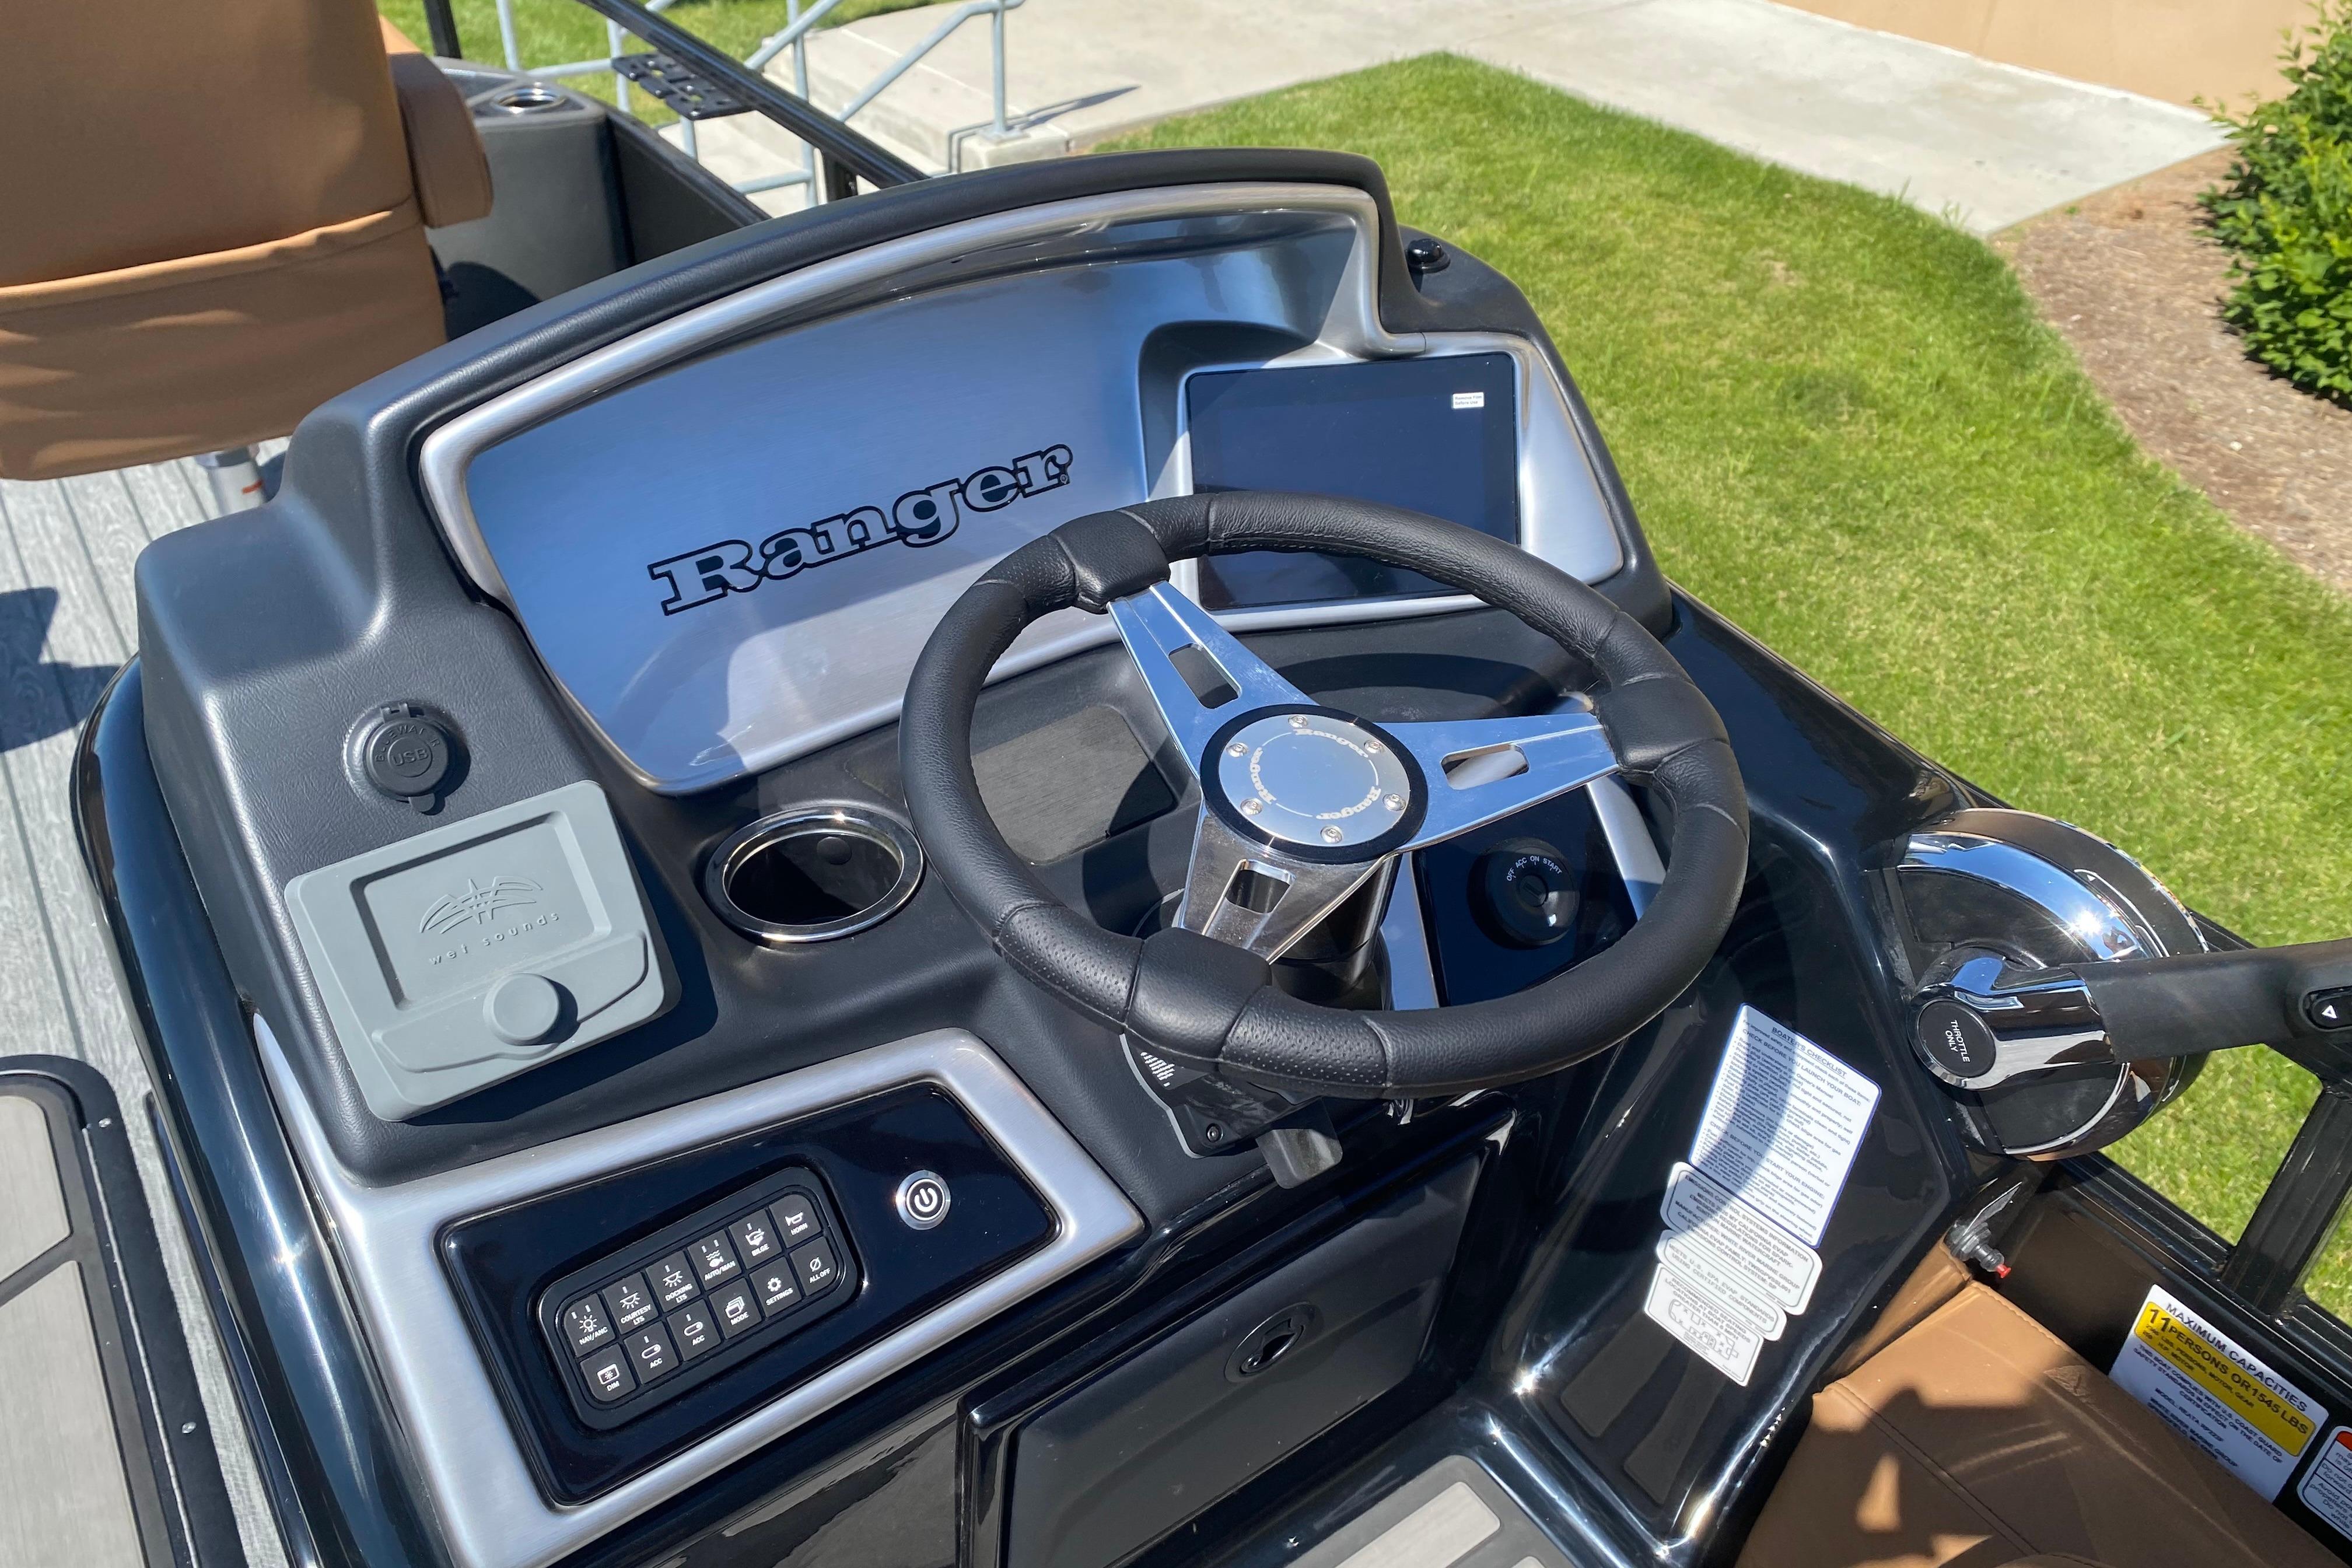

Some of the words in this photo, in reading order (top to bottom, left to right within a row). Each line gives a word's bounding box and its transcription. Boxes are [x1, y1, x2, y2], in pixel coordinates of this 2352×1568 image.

[648, 443, 1073, 616] Ranger
[393, 748, 429, 766] USB
[1293, 729, 1368, 758] Ranger
[1506, 868, 1515, 881] OFF
[1515, 857, 1527, 868] ACC
[1543, 858, 1563, 874] START
[429, 944, 468, 965] wet
[482, 911, 560, 946] sounds
[1772, 1026, 1805, 1051] BOATER'S
[1806, 1048, 1847, 1077] CHECKLIST
[1945, 1030, 1958, 1052] ONLY
[1951, 1020, 1971, 1062] THROTTLE
[1742, 1028, 1763, 1044] CHECK
[1763, 1041, 1787, 1059] BEFORE
[1787, 1056, 1800, 1068] YOU
[1800, 1065, 1825, 1083] LAUNCH
[1826, 1081, 1843, 1094] YOUR
[1770, 1037, 1783, 1047] safety
[1814, 1064, 1828, 1075] check
[1828, 1073, 1839, 1082] each
[1844, 1083, 1857, 1093] these
[1796, 1073, 1815, 1087] Owner's
[1815, 1085, 1833, 1099] Manual
[1710, 1120, 1729, 1135] CHECK
[1730, 1133, 1752, 1150] BEFORE
[1753, 1149, 1765, 1159] YOU
[1766, 1157, 1784, 1172] START
[1784, 1170, 1801, 1183] YOUR
[790, 1222, 808, 1236] HORN
[1677, 1210, 1709, 1236] CALIFORNIA
[1710, 1233, 1725, 1247] EVAP
[1685, 1174, 1714, 1197] EMISSIONS
[1714, 1195, 1741, 1216] CONTROL
[1742, 1213, 1768, 1234] SYSTEMS
[1769, 1232, 1808, 1262] INFORMATION
[1696, 1192, 1715, 1208] MEETS
[1728, 1213, 1737, 1223] MY
[1737, 1220, 1772, 1247] CALIFORNIA
[1772, 1244, 1788, 1258] EVAP
[1687, 1224, 1716, 1248] EMISSIONS
[1716, 1245, 1742, 1266] CONTROL
[1696, 1205, 1720, 1224] IGNITION
[1720, 1222, 1741, 1240] MARINE
[1742, 1237, 1781, 1266] WATERCRAFT
[1719, 1214, 1758, 1244] REGULATIONS
[1759, 1241, 1771, 1253] FOR
[751, 1242, 769, 1256] BILGE
[1720, 1232, 1738, 1247] WHITE
[1738, 1244, 1756, 1259] RIVER
[1756, 1256, 1778, 1275] MARINE
[1779, 1272, 1800, 1290] GROUP
[704, 1260, 736, 1281] AUTO/MAN
[808, 1272, 821, 1283] ALL
[820, 1267, 831, 1278] OFF
[1668, 1243, 1687, 1259] MEETS
[1689, 1258, 1704, 1272] U.S.
[1707, 1270, 1719, 1282] EPA
[1721, 1281, 1737, 1296] EVAP
[1740, 1294, 1775, 1322] STANDARDS
[664, 1283, 693, 1301] DOCKING
[675, 1293, 688, 1303] LTS
[765, 1287, 793, 1306] SETTINGS
[1671, 1253, 1690, 1269] USING
[1692, 1268, 1726, 1294] CERTIFIED
[1728, 1293, 1767, 1324] COMPONENTS
[620, 1303, 652, 1325] COURTESY
[632, 1314, 645, 1325] LTS
[730, 1311, 749, 1325] MODE
[1664, 1278, 1698, 1305] LOCATIONS
[1699, 1303, 1707, 1311] AT
[1707, 1309, 1725, 1324] BOAT
[1726, 1322, 1751, 1343] SPEEDS
[1671, 1278, 1718, 1314] RECOMMENDED
[1719, 1312, 1746, 1334] SEATING
[1672, 1290, 1702, 1314] GREATER
[1702, 1311, 1718, 1326] THAN
[1724, 1327, 1738, 1340] MPH
[579, 1326, 608, 1346] NAV/ANC
[691, 1334, 705, 1346] ACC
[649, 1357, 663, 1368] ACC
[2150, 1309, 2171, 1332] 11
[2168, 1325, 2230, 1375] PERSONS
[2230, 1371, 2252, 1392] OR
[2250, 1386, 2281, 1414] 1545
[2280, 1409, 2309, 1435] LBS
[2166, 1303, 2227, 1353] MAXIMUM
[2228, 1349, 2308, 1413] CAPACITIES
[2170, 1351, 2194, 1371] MOTOR
[606, 1380, 620, 1391] DIM
[2138, 1343, 2153, 1357] THIS
[2154, 1355, 2171, 1371] BOAT
[2171, 1368, 2204, 1396] COMPLIES
[2203, 1394, 2221, 1409] WITH
[2234, 1418, 2258, 1438] COAST
[2258, 1436, 2283, 1457] GUARD
[2234, 1391, 2254, 1408] GEAR
[2133, 1347, 2157, 1367] SAFETY
[2157, 1366, 2195, 1397] STANDARDS
[2203, 1402, 2228, 1423] EFFECT
[2228, 1420, 2239, 1431] ON
[2239, 1429, 2251, 1441] THE
[2251, 1438, 2272, 1456] DATE
[2272, 1454, 2283, 1465] OF
[2179, 1390, 2227, 1429] CERTIFICATION
[2150, 1396, 2170, 1415] WHITE
[2169, 1412, 2189, 1430] RIVER
[2189, 1427, 2214, 1449] MARINE
[2213, 1447, 2238, 1468] GROUP
[2336, 1452, 2352, 1465] may
[2322, 1463, 2332, 1473] Do
[2334, 1474, 2347, 1484] not
[2323, 1471, 2352, 1494] forward
[2309, 1484, 2347, 1513] propellers
[2318, 1483, 2340, 1500] Avoid
[2323, 1499, 2334, 1509] Do
[2336, 1510, 2348, 1520] not
[2331, 1513, 2350, 1528] while
